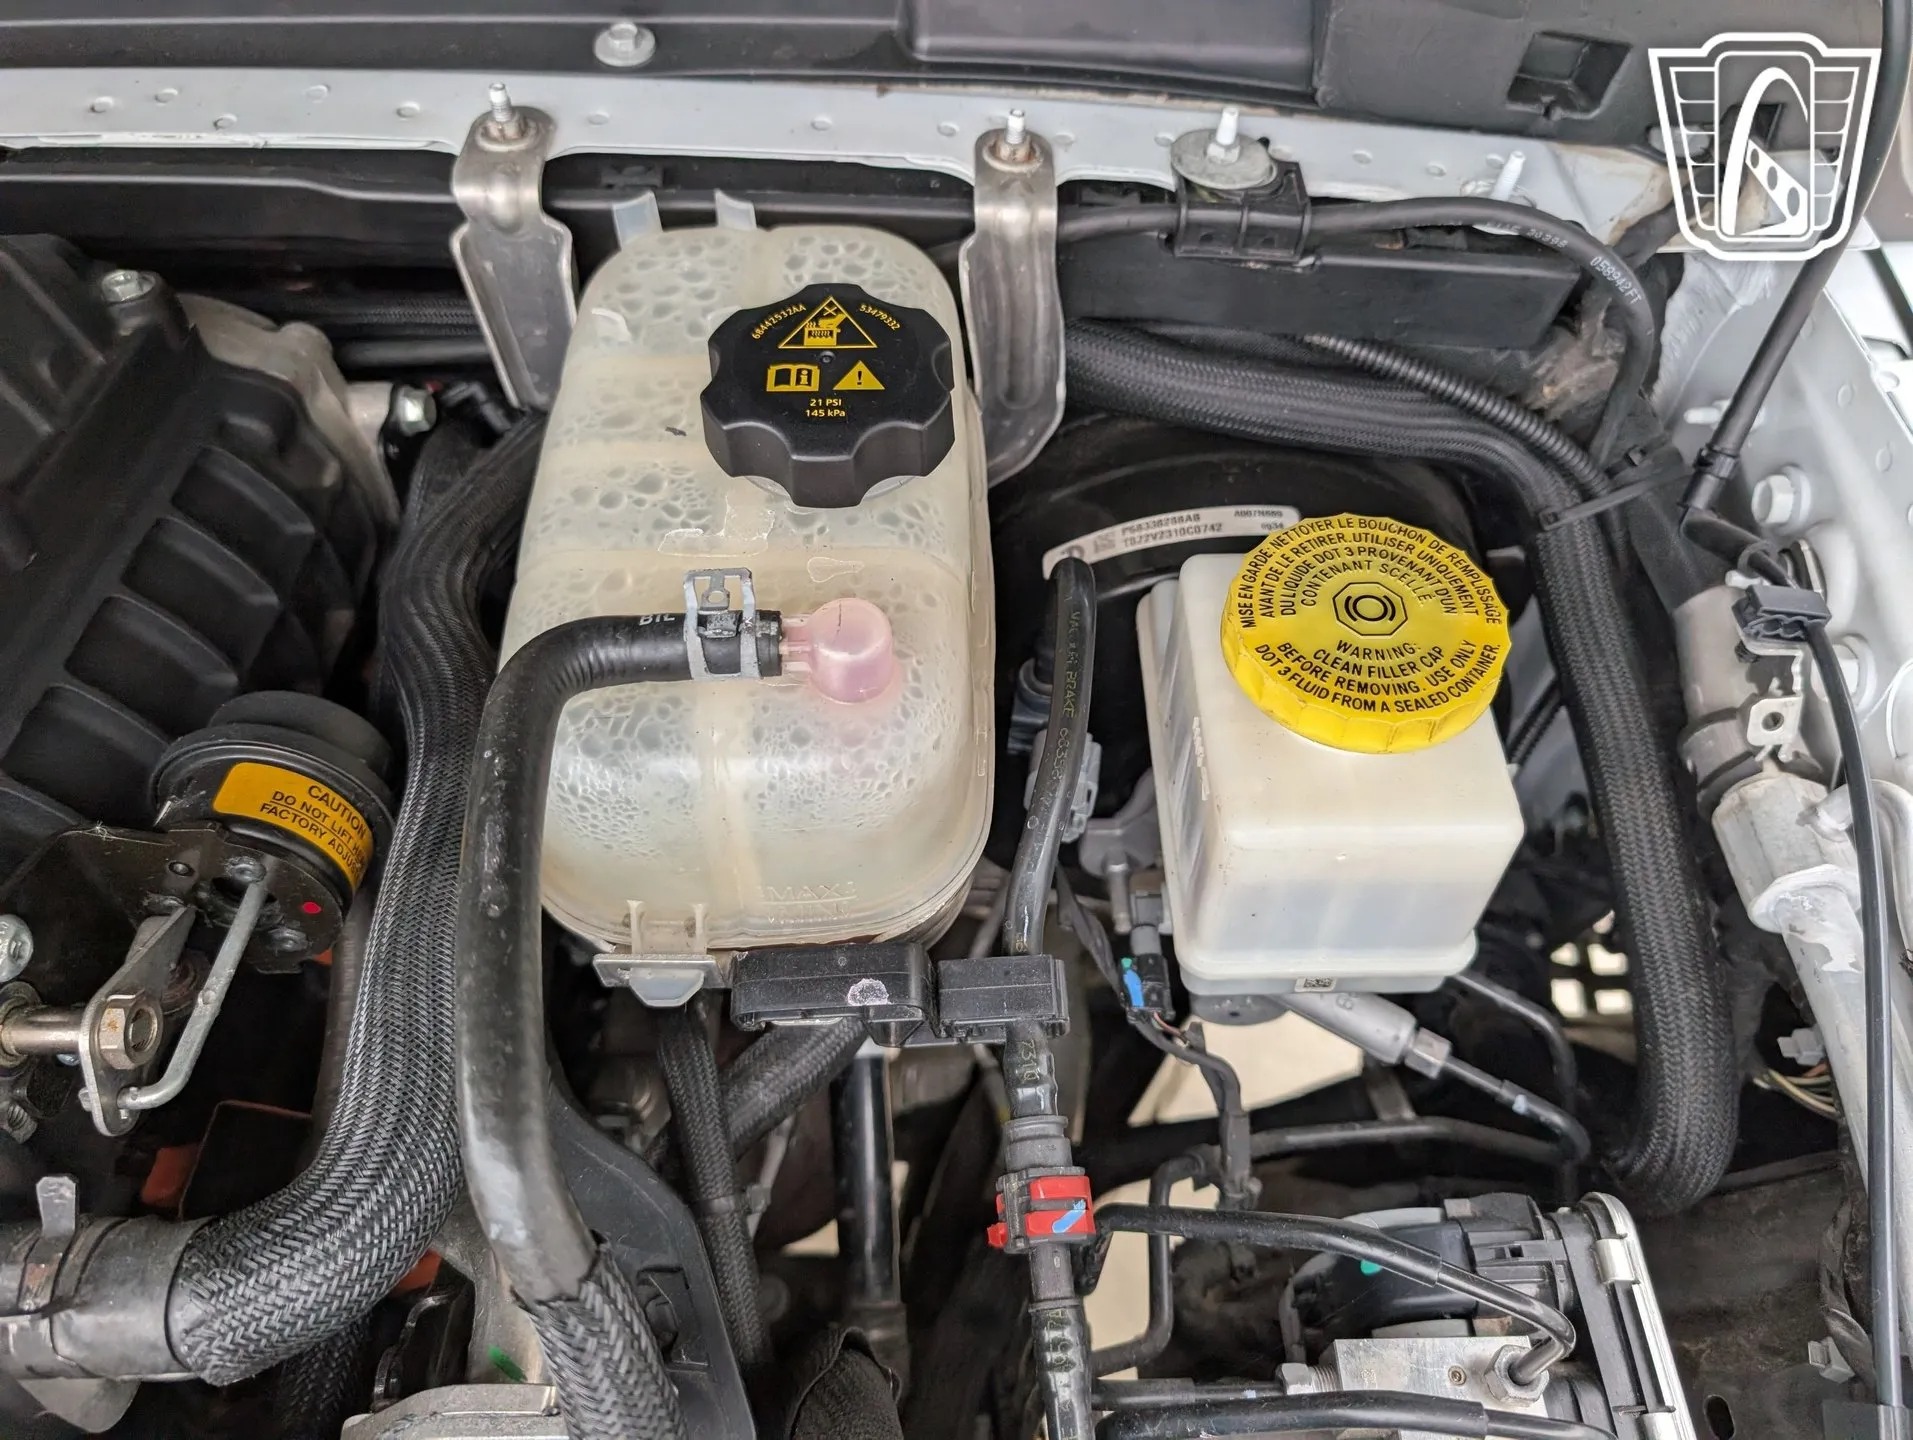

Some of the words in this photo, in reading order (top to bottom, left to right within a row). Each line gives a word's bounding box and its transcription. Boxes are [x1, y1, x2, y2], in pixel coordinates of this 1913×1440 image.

[751, 304, 807, 340] 68442532AA
[858, 303, 900, 331] 53479332
[806, 409, 825, 417] 145
[827, 409, 846, 417] kPa
[810, 399, 822, 407] 21
[826, 399, 842, 407] PSI
[1269, 519, 1335, 550] NETTOYER
[1338, 518, 1354, 528] LE
[1358, 519, 1427, 544] BOUCHON
[1312, 548, 1342, 564] DOT
[1345, 547, 1354, 557] 3
[1352, 533, 1416, 555] UTILISER
[1428, 540, 1448, 555] DE
[1242, 547, 1276, 583] GARDE:
[1265, 566, 1283, 582] DE
[1275, 553, 1295, 569] LE
[1358, 546, 1442, 586] PROVENANT
[1238, 584, 1254, 600] EN
[1280, 560, 1316, 599] LIQUIDE
[1301, 560, 1373, 607] CONTENANT
[1416, 550, 1479, 616] UNIQUEMENT
[1445, 552, 1502, 625] REMPLISSAGE
[1258, 582, 1276, 618] AVANT
[1280, 600, 1297, 616] DU
[1434, 587, 1458, 614] D'UN
[1238, 602, 1257, 628] MISE
[1313, 649, 1362, 676] CLEAN
[1367, 661, 1421, 679] FILLER
[1420, 646, 1444, 668] CAP
[1336, 640, 1421, 660] WARNING:
[1255, 644, 1284, 667] DOT
[1277, 666, 1291, 676] 3
[1288, 672, 1330, 699] FLUID
[1331, 692, 1376, 712] FROM
[1381, 701, 1390, 713] A
[1394, 691, 1449, 713] SEALED
[1447, 644, 1501, 698] CONTAINER.
[1277, 642, 1332, 683] BEFORE
[1334, 676, 1426, 696] REMOVING.
[1424, 666, 1455, 687] USE
[1449, 639, 1477, 669] ONLY
[1063, 671, 1078, 718] BRAKE
[260, 803, 328, 839] FACTORY
[272, 791, 296, 806] DO
[300, 801, 330, 822] NOT
[330, 821, 353, 844] LIFT
[308, 785, 367, 840] CAUTION
